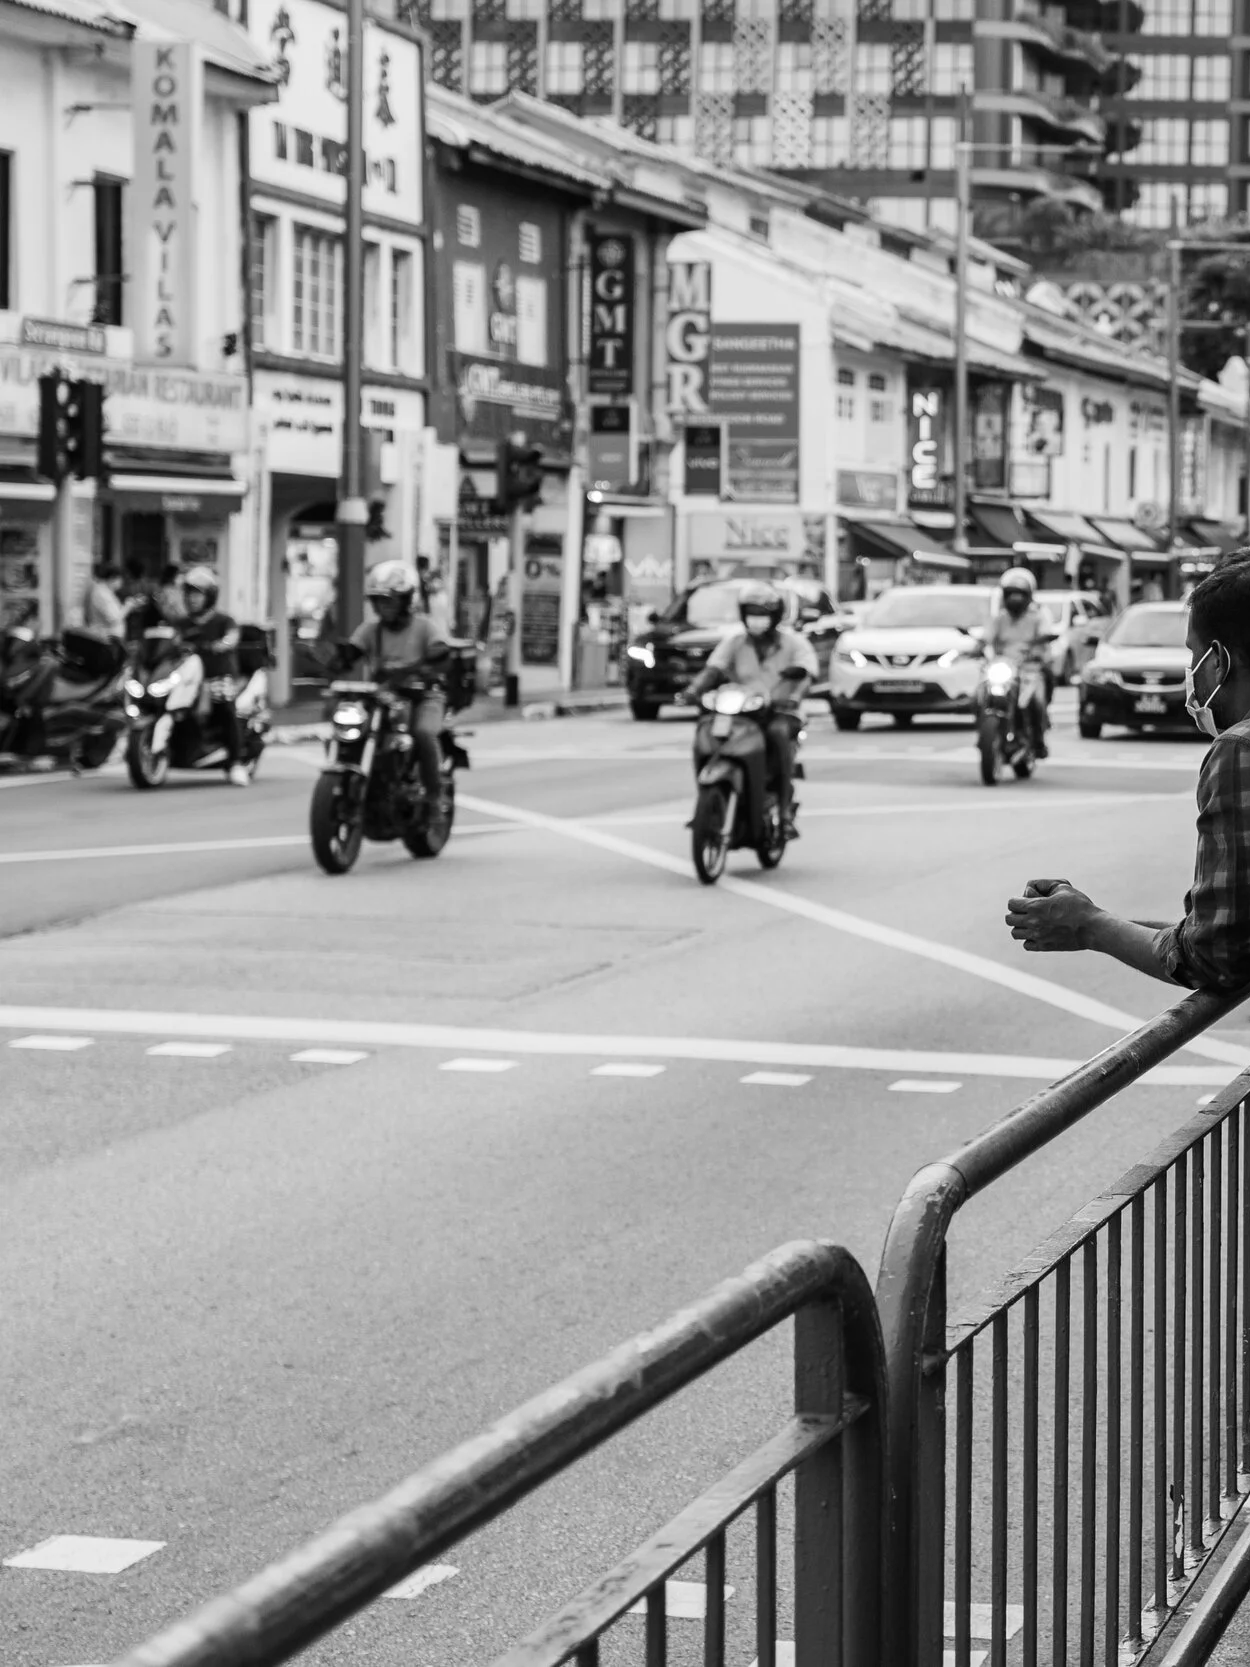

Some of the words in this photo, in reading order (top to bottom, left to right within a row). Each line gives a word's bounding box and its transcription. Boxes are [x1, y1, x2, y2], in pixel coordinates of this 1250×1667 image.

[150, 48, 177, 209] KOMALA
[152, 221, 176, 358] VILAS
[667, 262, 711, 413] MGR
[912, 391, 939, 489] NICE
